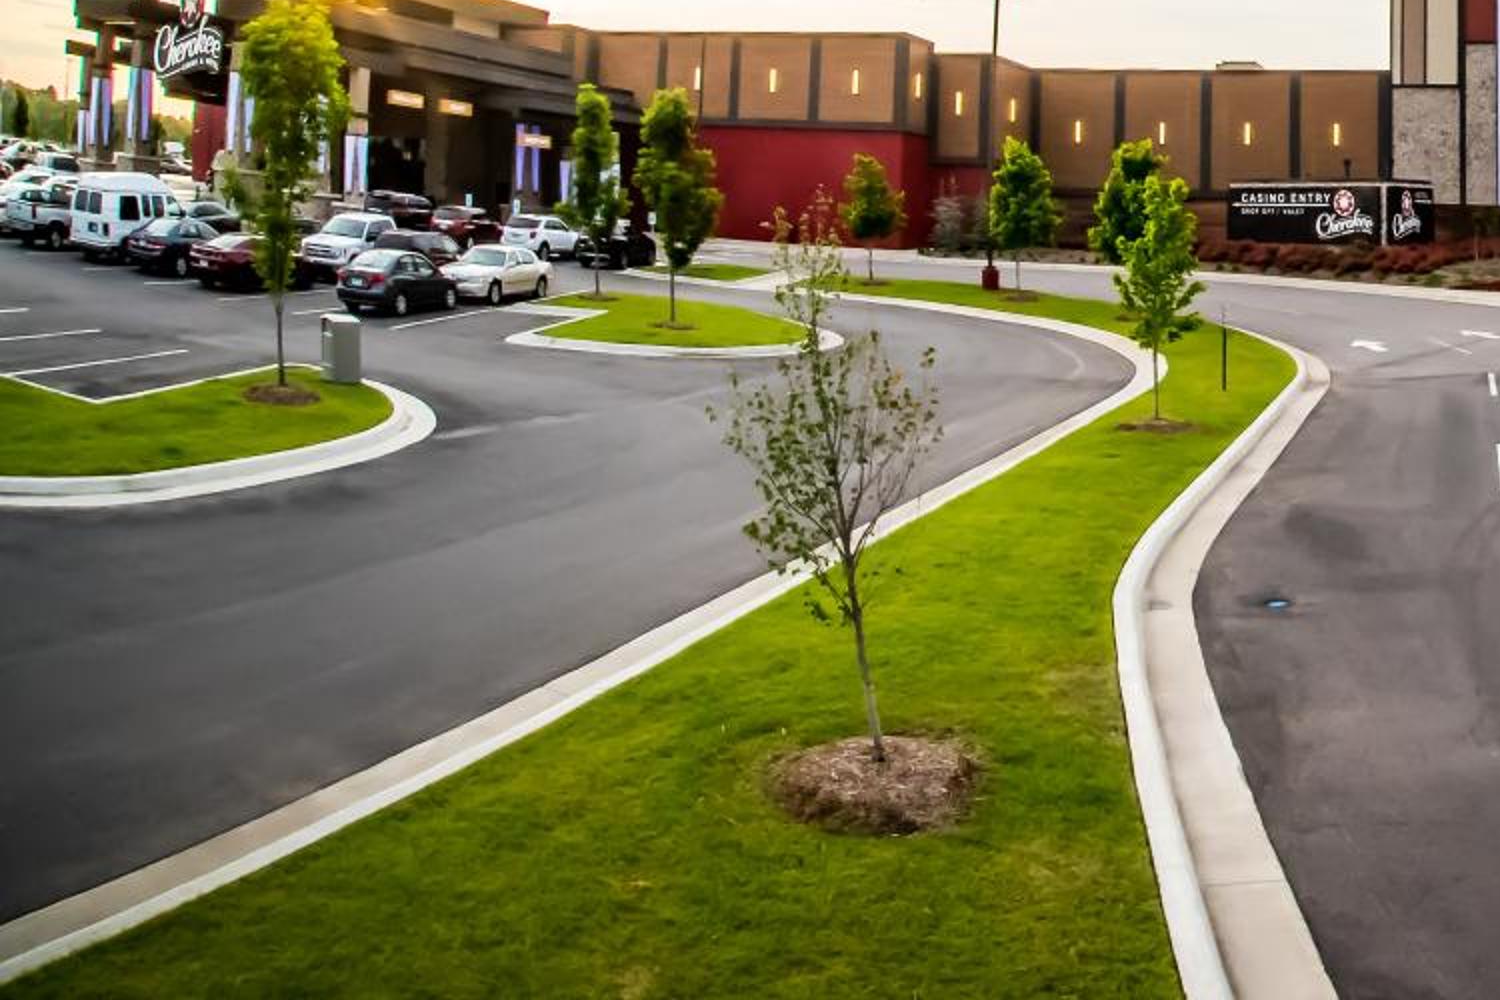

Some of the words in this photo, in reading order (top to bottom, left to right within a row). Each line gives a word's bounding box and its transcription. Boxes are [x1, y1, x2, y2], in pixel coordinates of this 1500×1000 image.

[153, 14, 222, 73] Cherokee
[1241, 192, 1286, 204] CASINO
[1290, 192, 1331, 204] ENTRY
[1315, 208, 1374, 237] Cherokee
